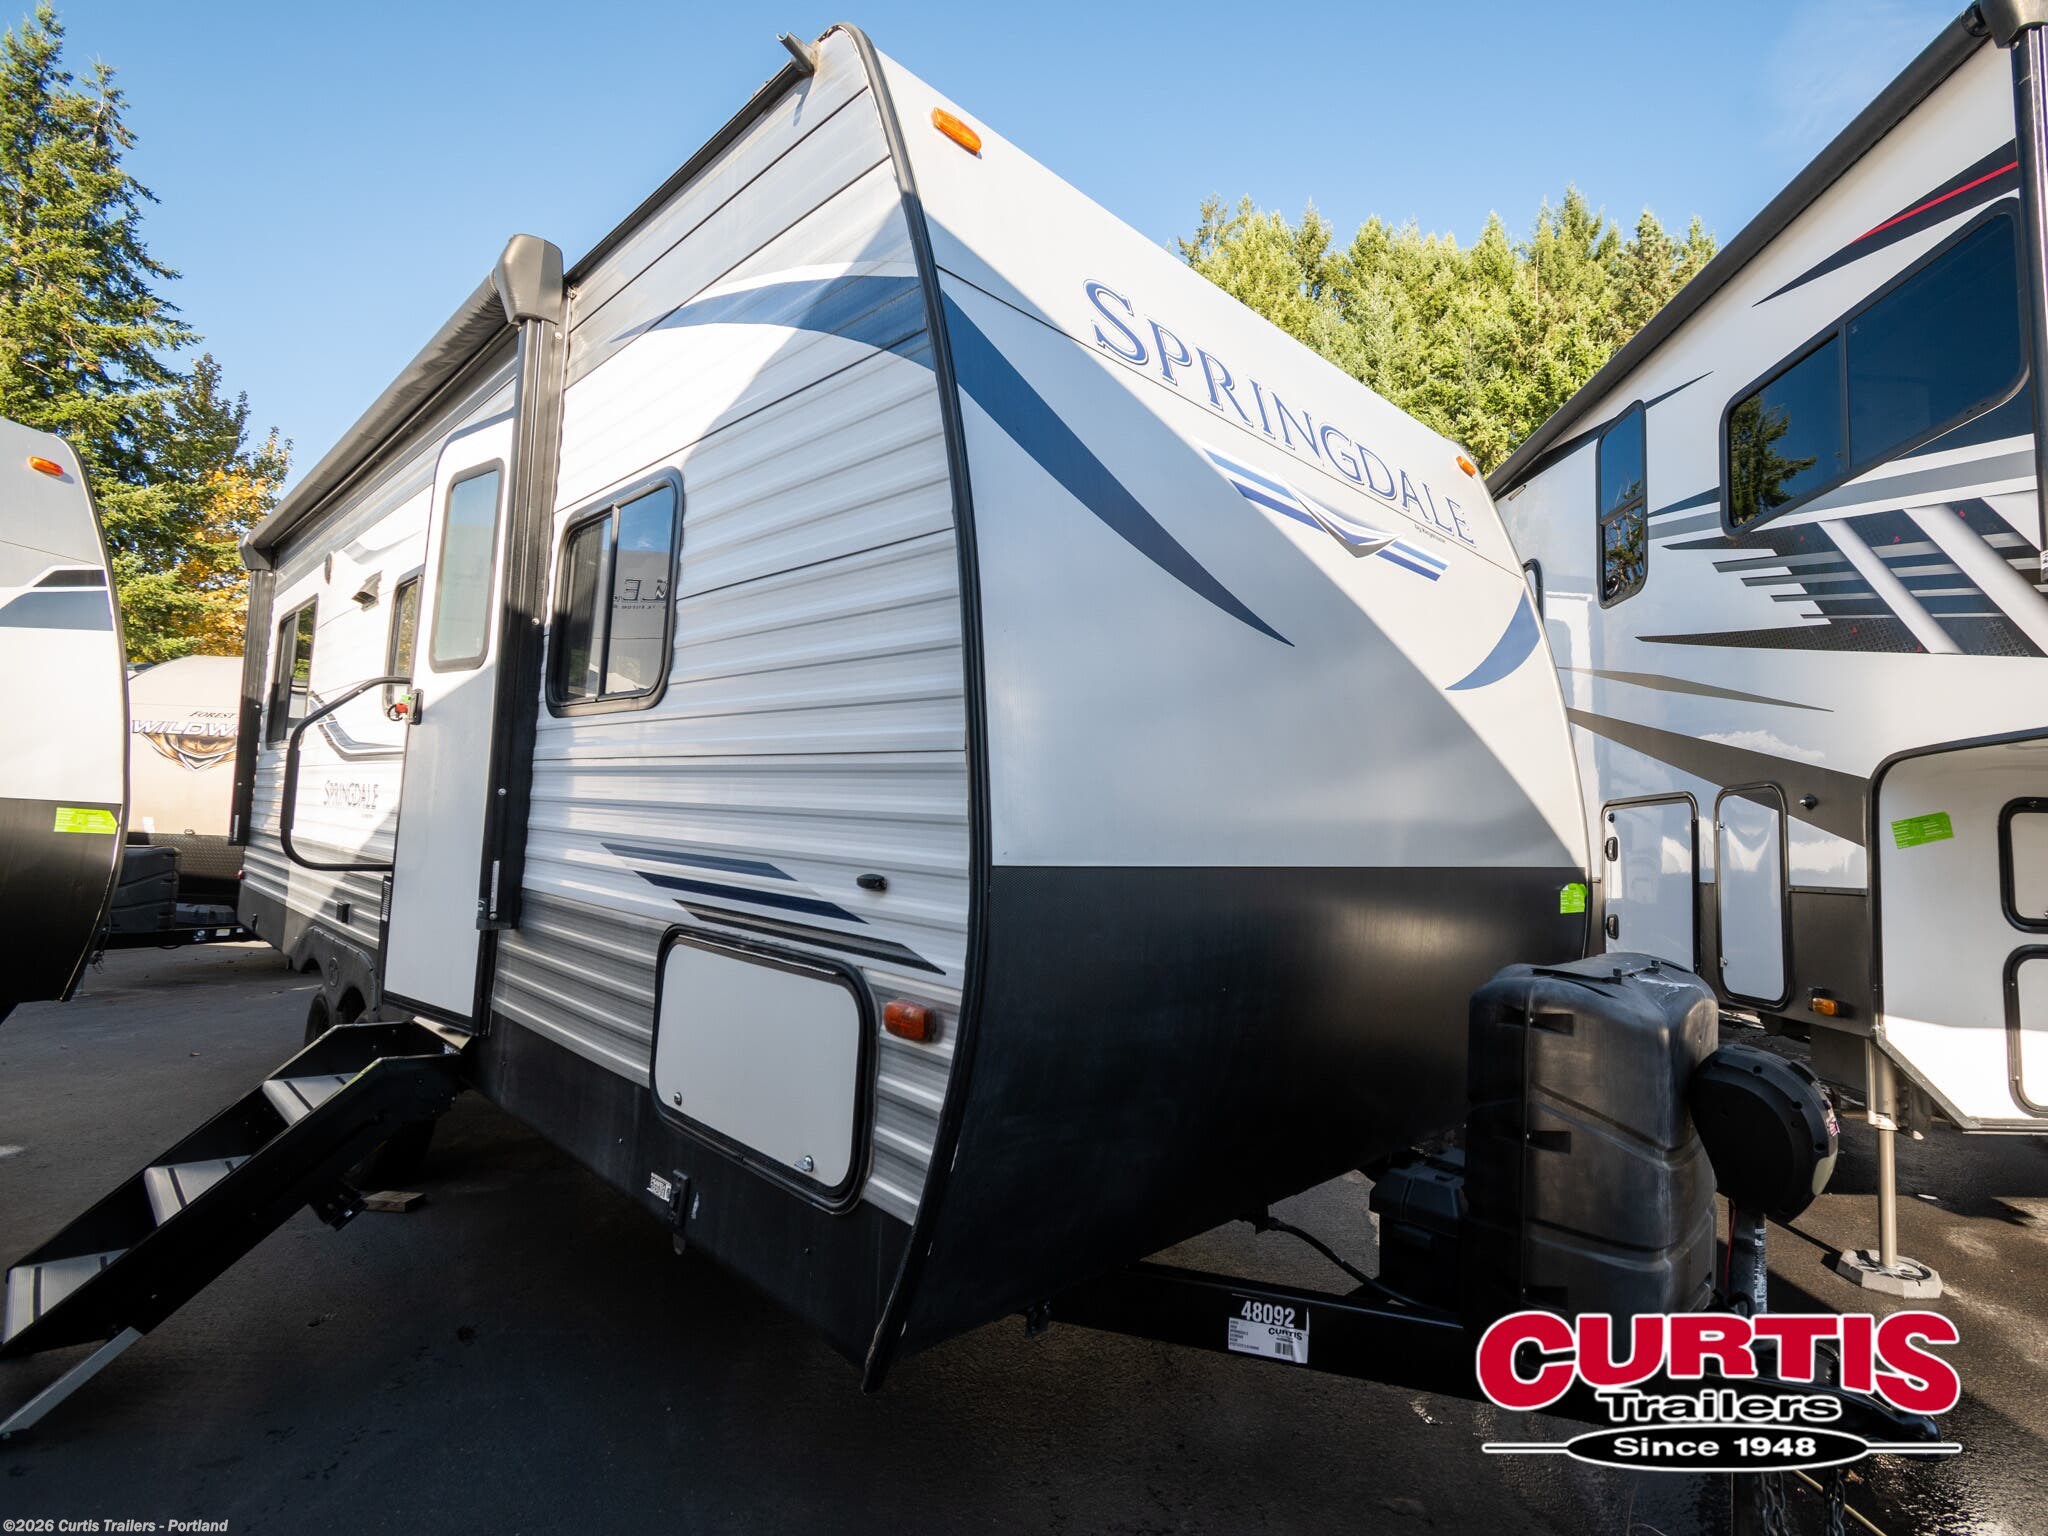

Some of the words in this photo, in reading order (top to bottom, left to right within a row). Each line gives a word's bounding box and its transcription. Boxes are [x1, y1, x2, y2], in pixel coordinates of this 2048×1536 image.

[1083, 278, 1476, 548] SPRINGDALE
[188, 710, 238, 718] FOREST
[131, 719, 239, 737] WILDW
[1241, 1300, 1295, 1328] 48092
[1268, 1327, 1303, 1341] CURTIS
